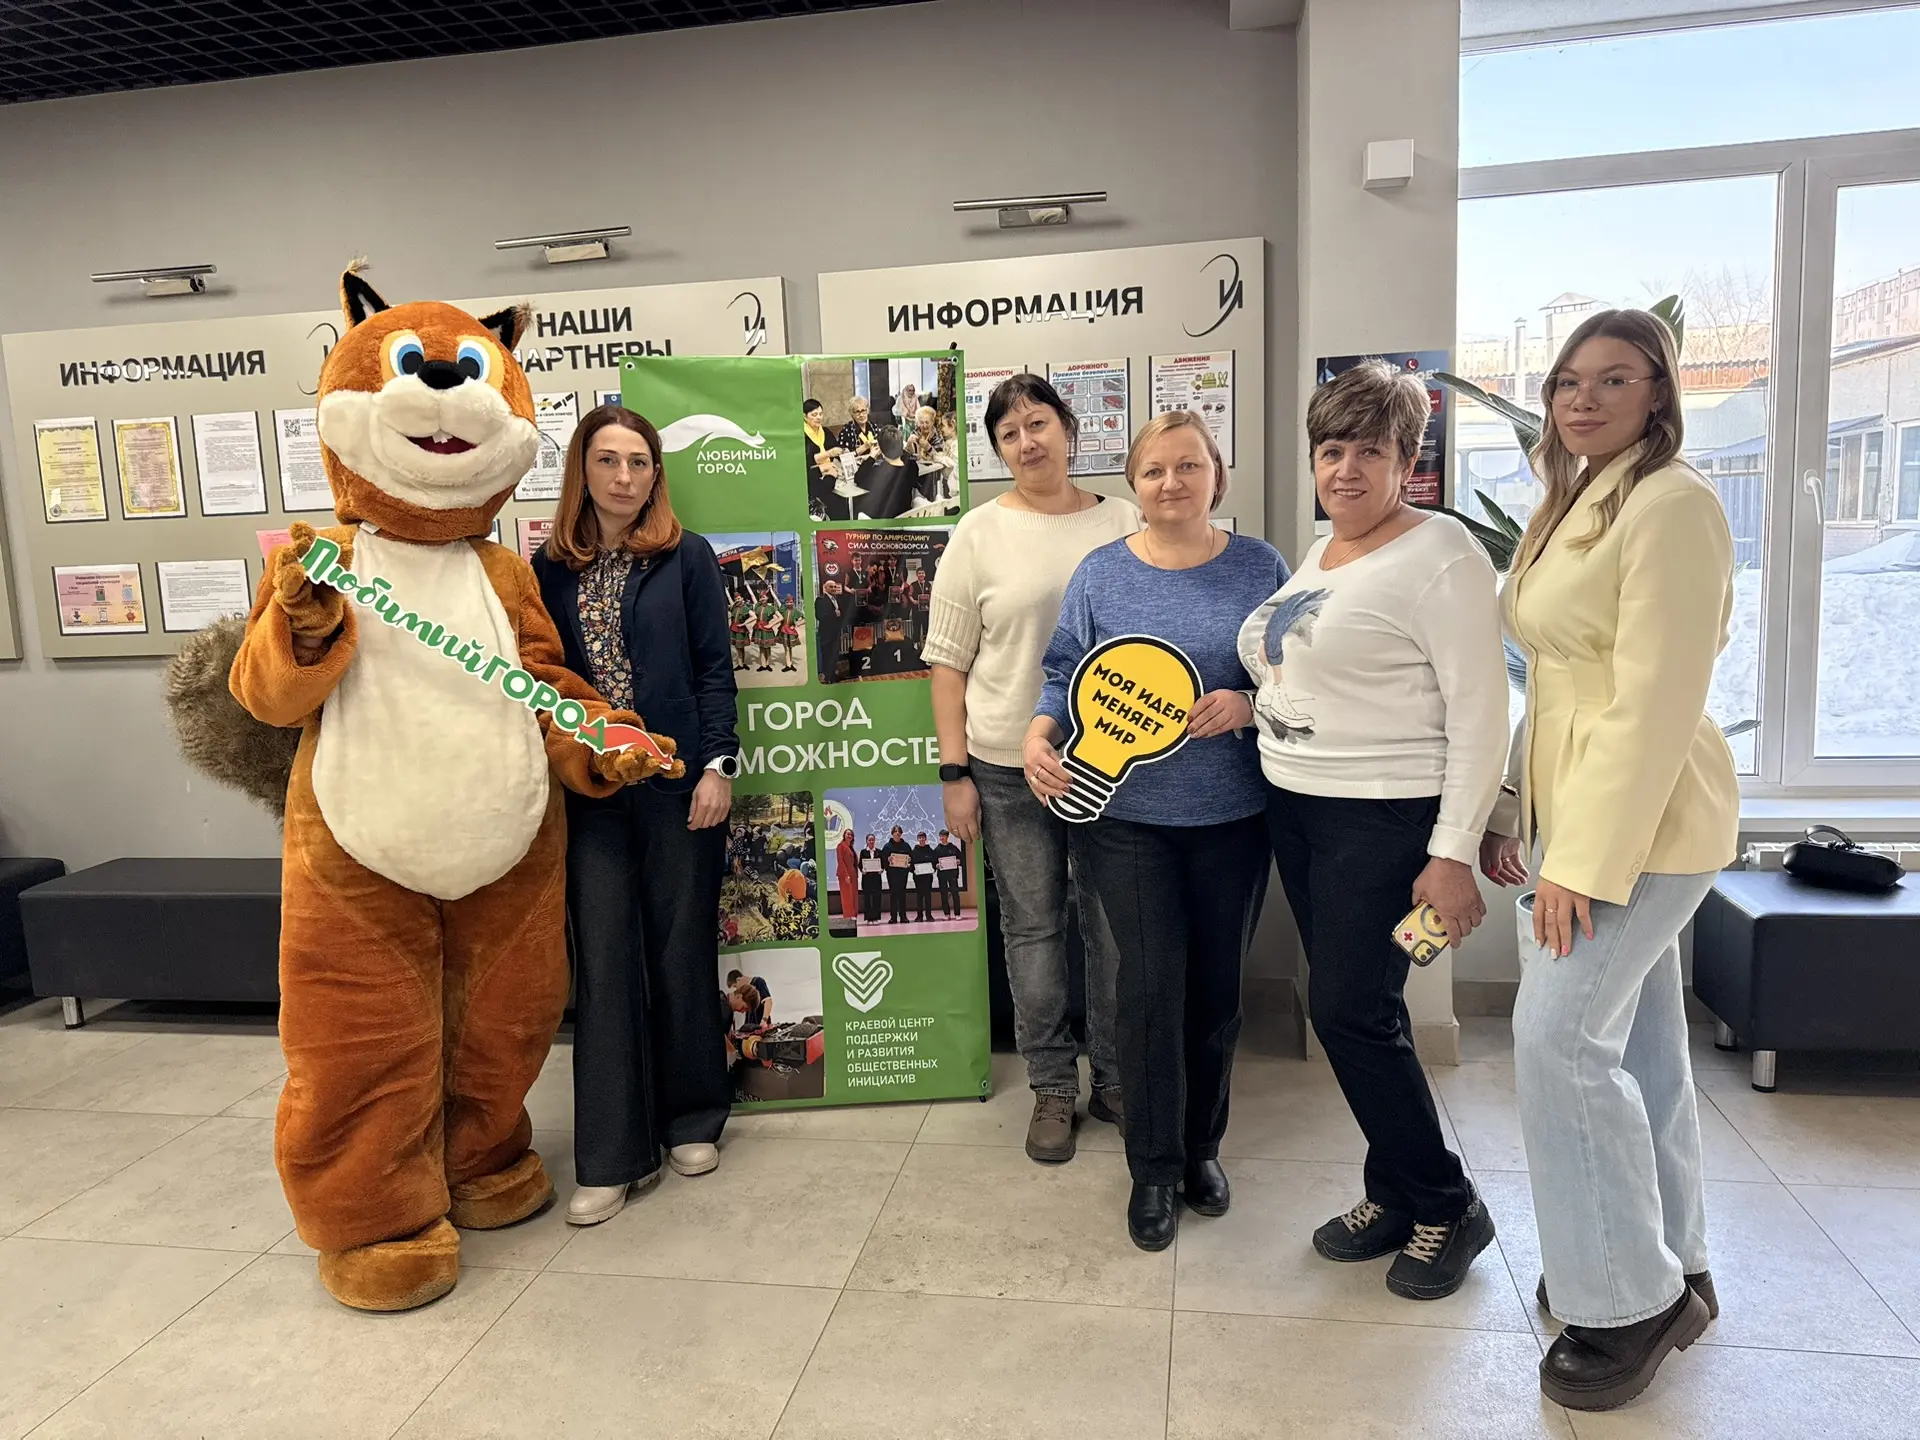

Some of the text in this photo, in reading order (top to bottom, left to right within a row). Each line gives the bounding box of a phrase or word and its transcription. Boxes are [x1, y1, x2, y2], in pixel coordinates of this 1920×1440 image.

[888, 286, 1144, 333] ИНФОРМАЦИЯ
[537, 306, 632, 338] НАШИ
[60, 350, 266, 386] ИНФОРМАЦИЯ
[964, 370, 1014, 378] ЕЗОПАСНОСТИ
[1068, 363, 1109, 371] ДОРОЖНОГО
[697, 447, 777, 461] ЛЮБИМЫЙ
[698, 463, 747, 475] ГОРОД
[884, 534, 930, 542] АРМРЕСТЛИНГУ
[870, 542, 929, 550] СОСНОВОБОРСКА
[861, 657, 872, 669] 2
[1093, 663, 1187, 724] МОЯ ИДЕЯ
[482, 658, 606, 752] ГОРОД
[747, 697, 872, 731] ГОРОД
[1092, 689, 1164, 736] МЕНЯЕТ
[1094, 716, 1136, 745] МИР
[737, 737, 940, 774] МОЖНОСТЕ
[845, 1017, 935, 1031] КРАЕВОЙ ЦЕНТР
[846, 1032, 918, 1045] ПОДДЕРЖКИ
[846, 1046, 915, 1059] И РАЗВИТИЯ
[847, 1059, 938, 1073] ОБЩЕСТВЕННЫХ
[848, 1074, 916, 1087] ИНИЦИАТИВ
